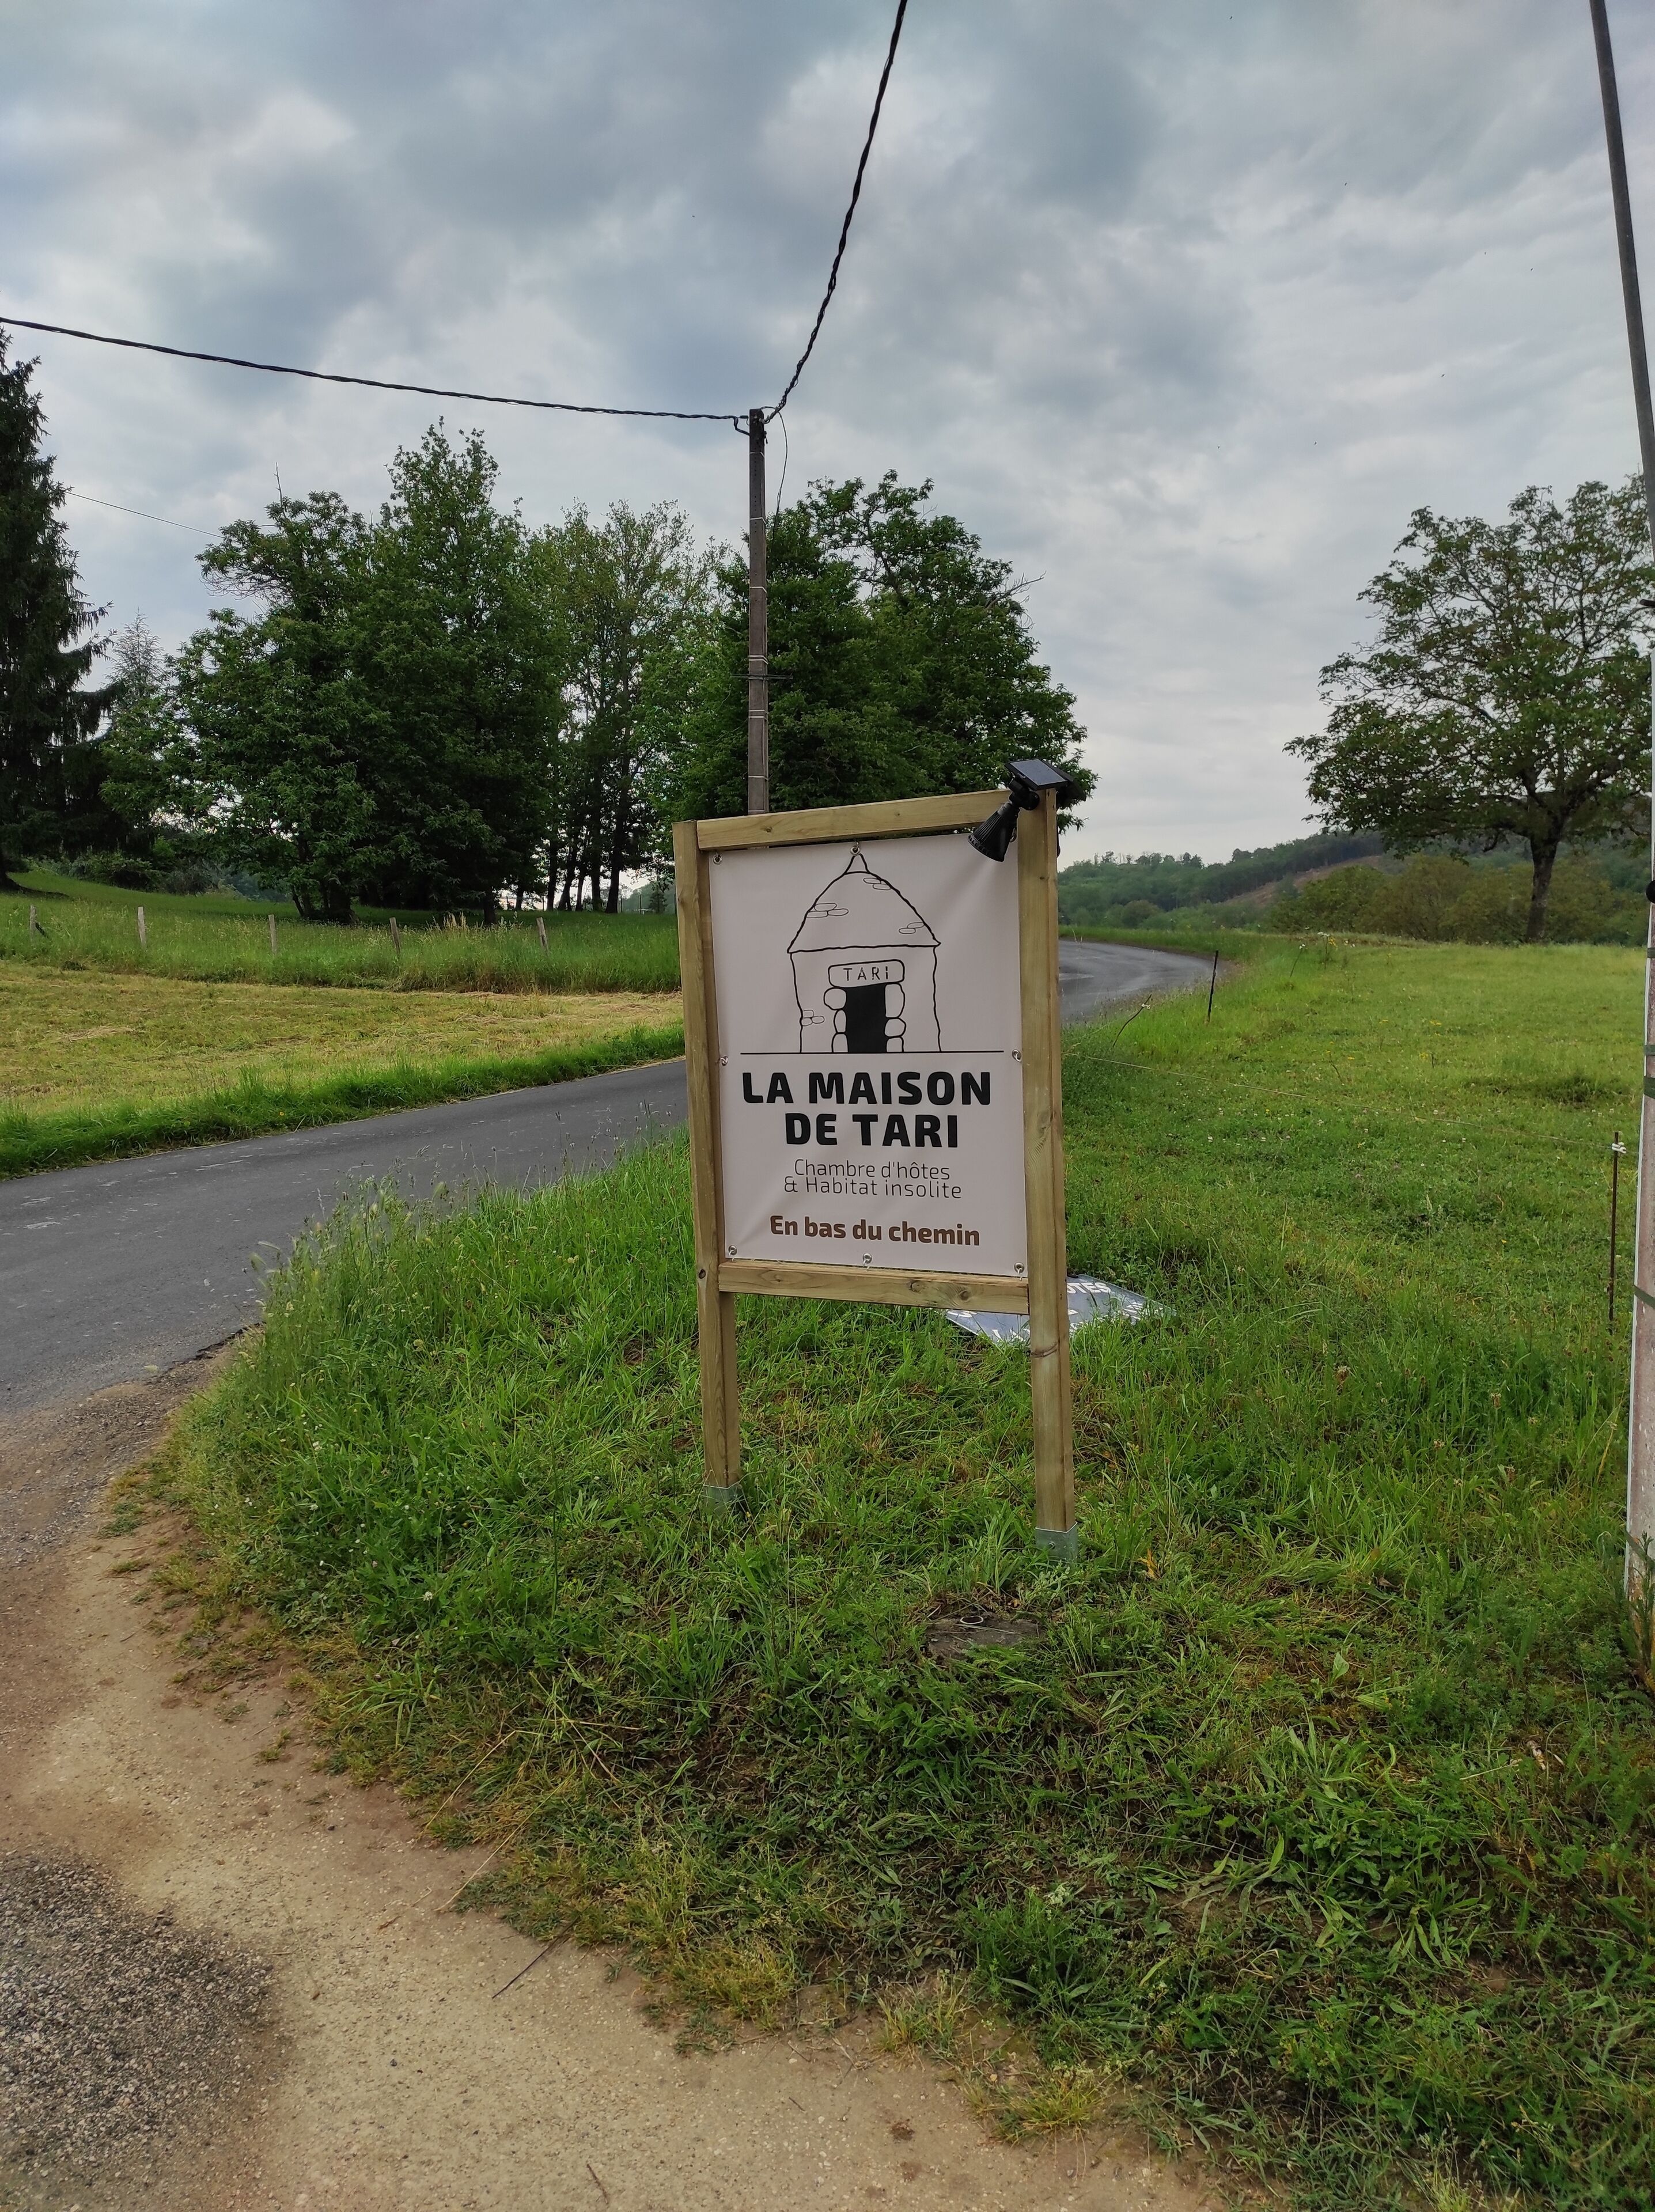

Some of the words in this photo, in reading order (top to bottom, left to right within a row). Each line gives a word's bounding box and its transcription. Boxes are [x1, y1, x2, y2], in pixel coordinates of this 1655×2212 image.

[843, 965, 889, 982] TARI
[742, 1072, 794, 1104] LA
[808, 1071, 991, 1106] MAISON
[785, 1112, 838, 1146] DE
[852, 1113, 958, 1148] TARI
[794, 1158, 875, 1178] Chambre
[881, 1161, 950, 1180] d'hôtes
[784, 1176, 798, 1193] &
[805, 1176, 878, 1196] Habitat
[884, 1180, 962, 1199] insolite
[770, 1215, 798, 1236] En
[804, 1216, 846, 1239] bas
[851, 1219, 882, 1241] du
[888, 1221, 980, 1246] chemin
